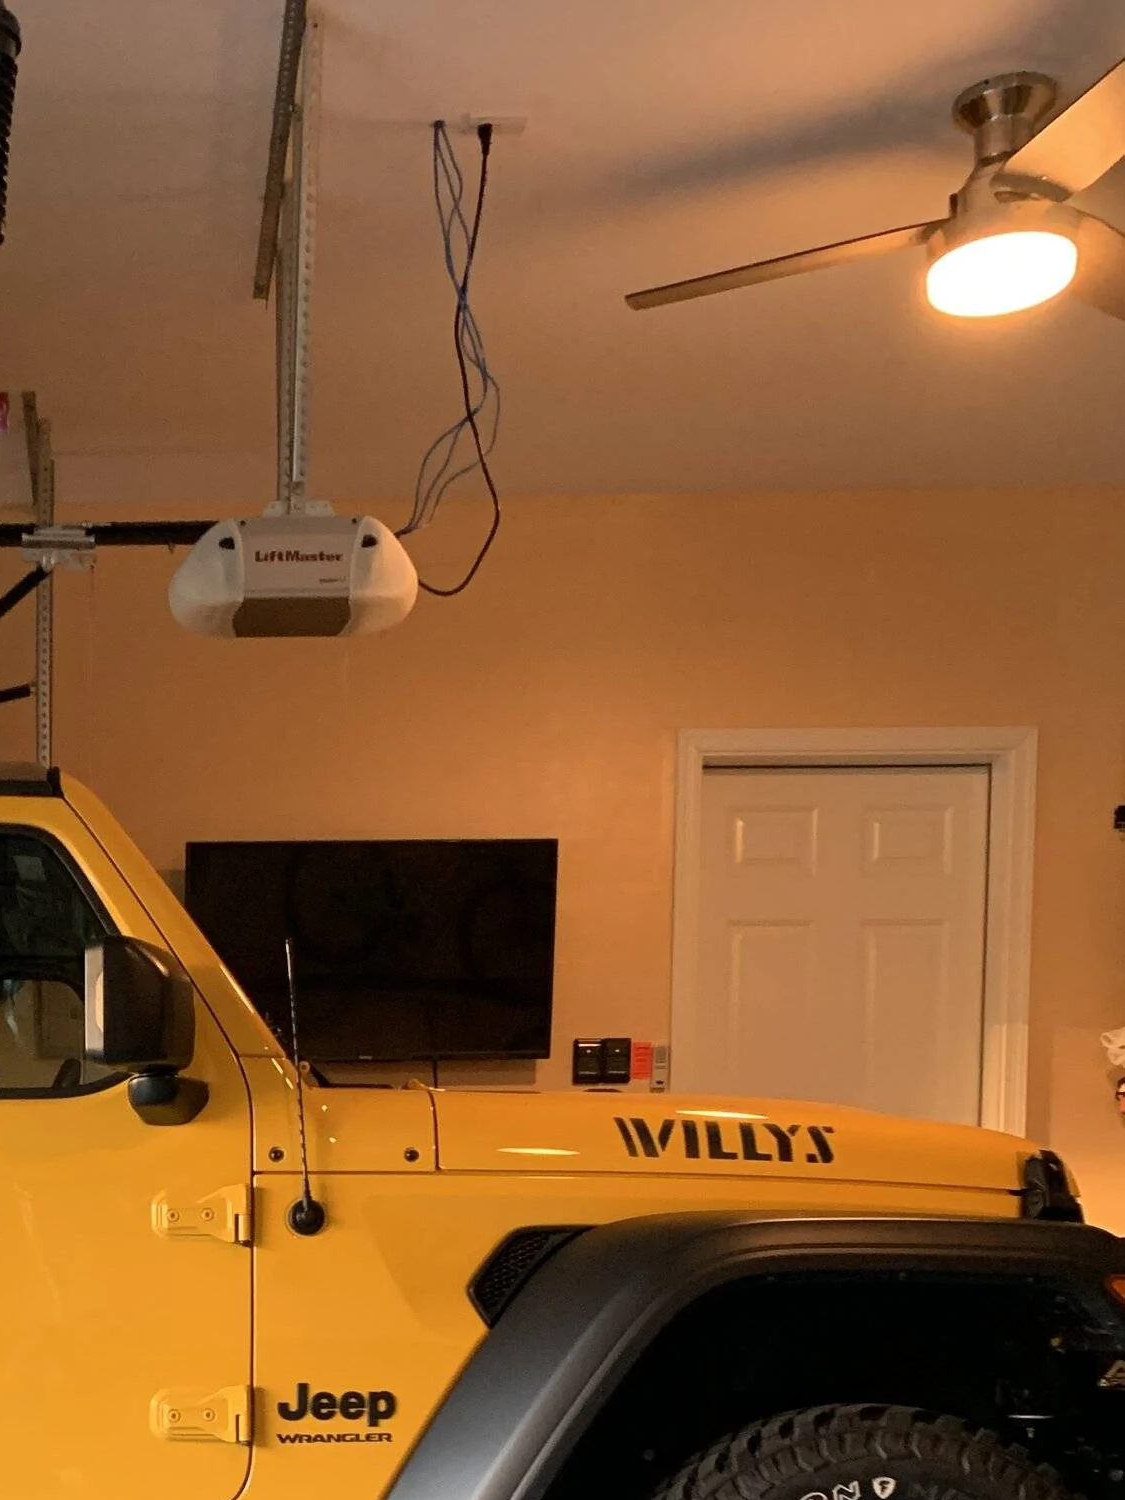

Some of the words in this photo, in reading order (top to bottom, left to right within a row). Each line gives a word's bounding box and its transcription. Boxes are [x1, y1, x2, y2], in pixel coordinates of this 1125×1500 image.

[255, 550, 343, 563] LiftMaster
[614, 1116, 836, 1164] WILLYS
[278, 1383, 396, 1427] Jeep
[277, 1433, 392, 1444] WRANGLER
